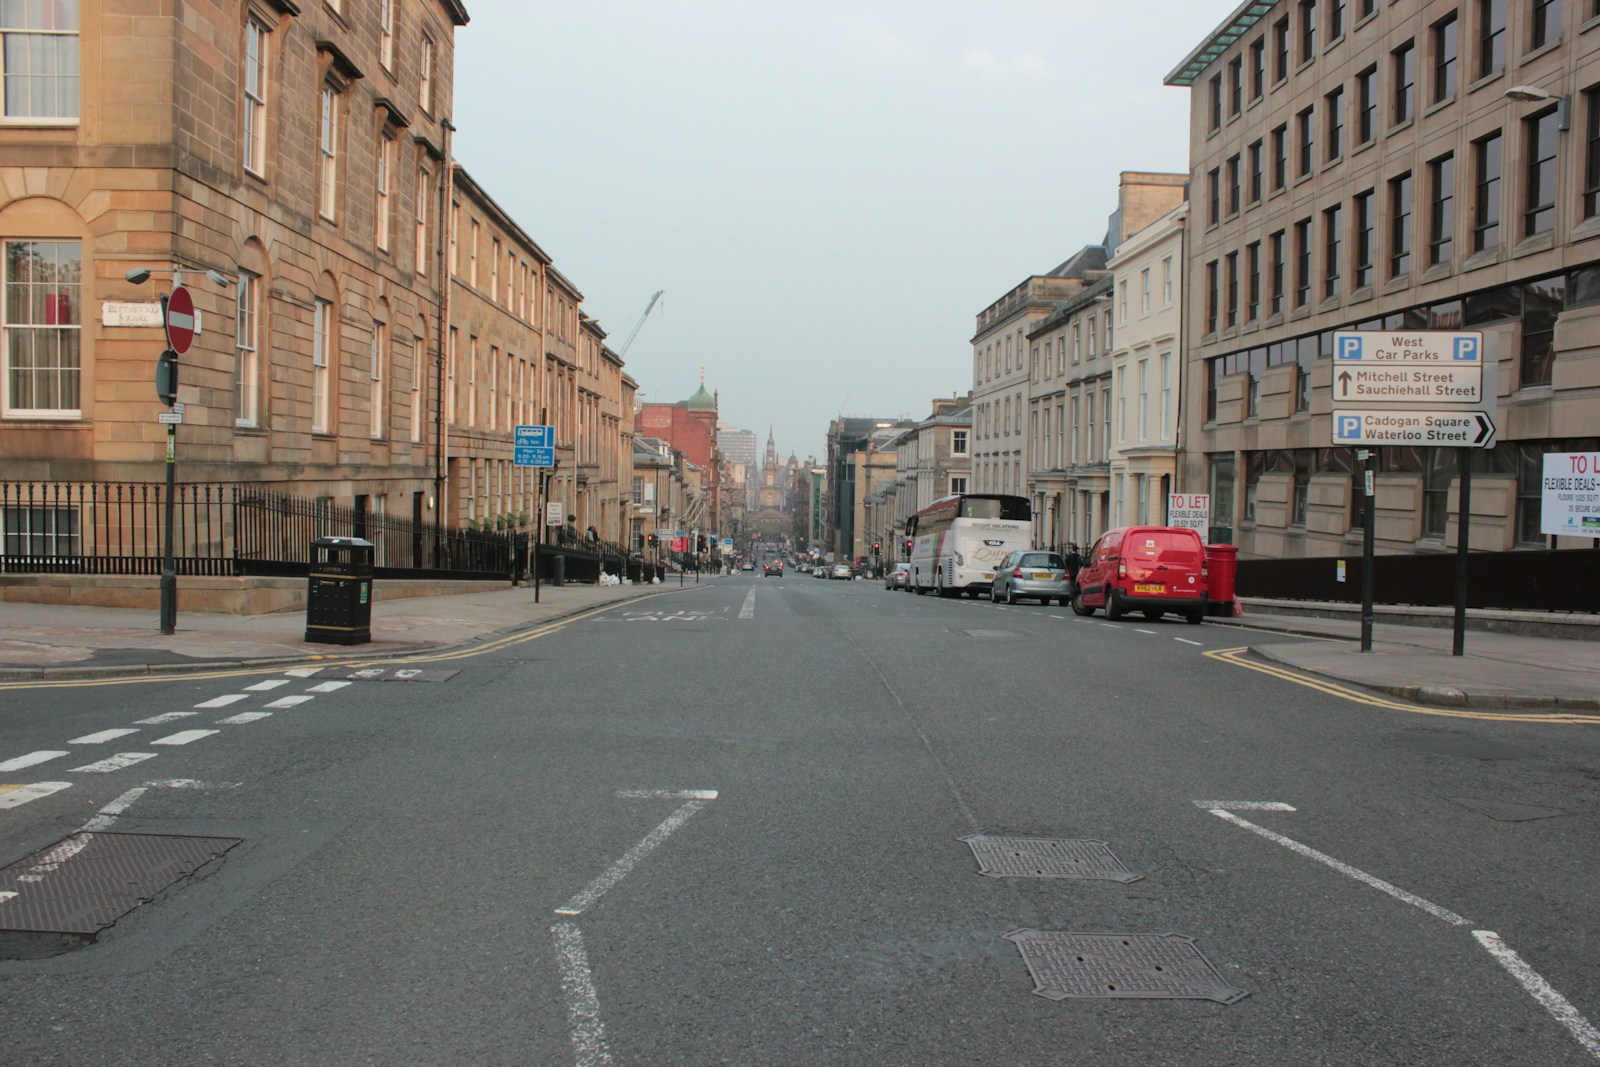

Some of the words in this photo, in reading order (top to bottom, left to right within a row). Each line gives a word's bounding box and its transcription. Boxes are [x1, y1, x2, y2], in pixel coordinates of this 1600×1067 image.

[1344, 339, 1359, 357] P
[1391, 337, 1423, 347] West
[1375, 349, 1397, 360] Car
[1403, 350, 1439, 360] Parks
[1459, 340, 1474, 358] P
[1356, 371, 1408, 382] Mitchell
[1413, 372, 1454, 383] Street
[1356, 385, 1430, 395] Sauchiehall
[1435, 386, 1476, 396] Street
[1343, 418, 1358, 437] P
[1364, 415, 1420, 428] Cadogan
[1425, 416, 1470, 428] Square
[1365, 429, 1422, 440] Waterloo
[1427, 430, 1467, 441] Street
[1570, 456, 1587, 474] TO
[1544, 477, 1572, 490] FLEXIBLE
[1574, 478, 1595, 491] DEALS
[1170, 495, 1184, 508] TO
[1188, 495, 1208, 509] LET
[1170, 510, 1191, 518] FLEXIBLE
[1192, 511, 1208, 519] DEALS
[1574, 505, 1591, 513] SECURE
